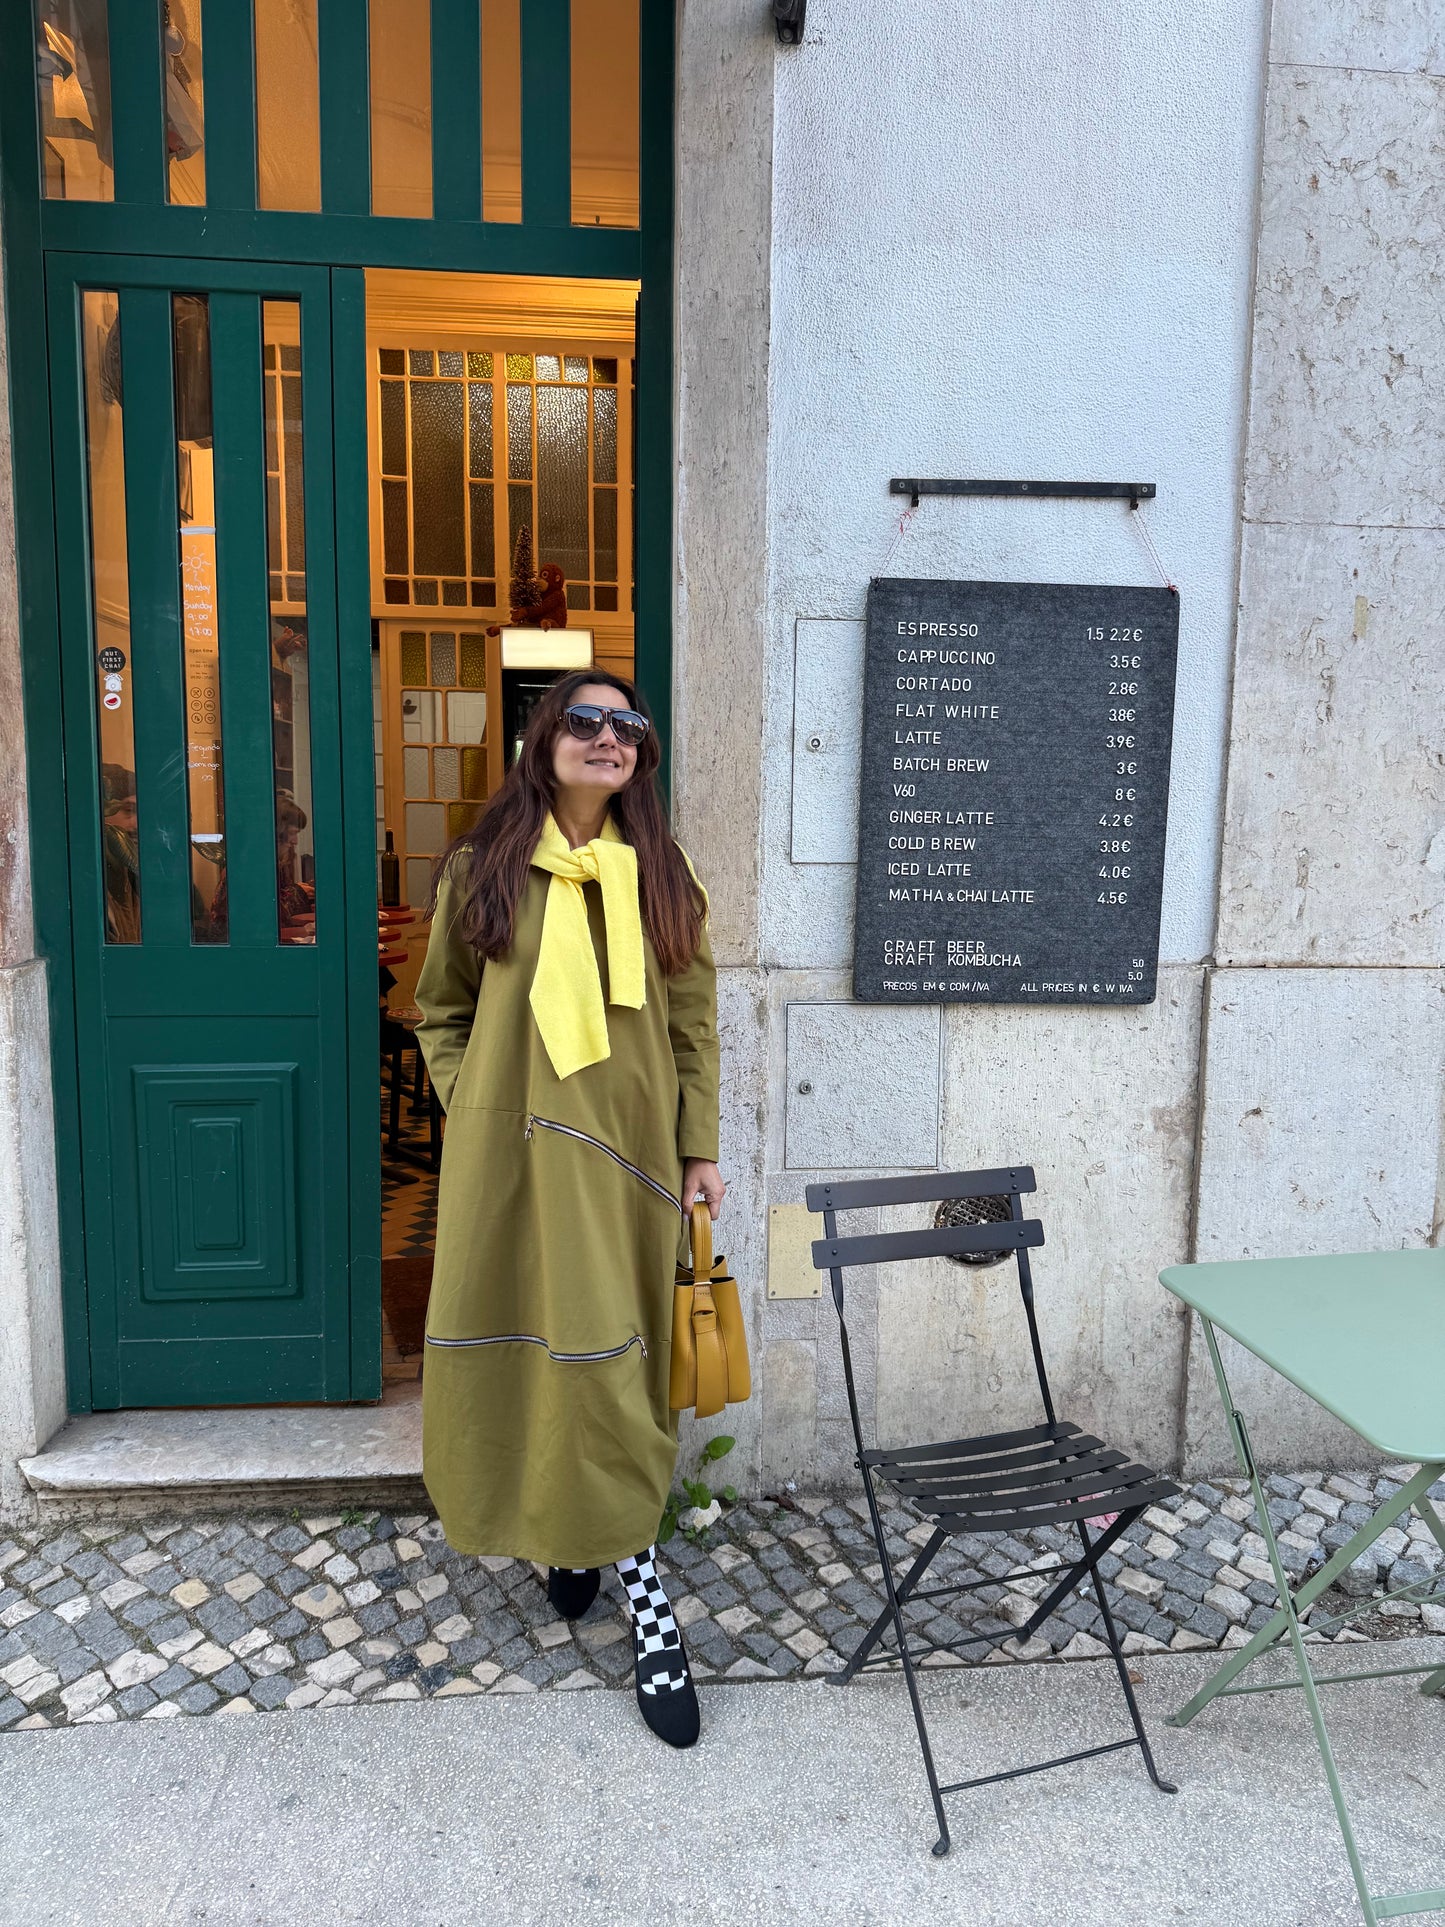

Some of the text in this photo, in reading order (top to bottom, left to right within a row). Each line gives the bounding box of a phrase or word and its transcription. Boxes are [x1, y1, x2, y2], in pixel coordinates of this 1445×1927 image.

[183, 600, 212, 613] Sunday
[898, 622, 978, 637] ESPRESSO
[1087, 628, 1103, 640] 1.5
[898, 650, 995, 665] CAPPUCCINO
[1110, 655, 1140, 668] 3.5€
[896, 677, 972, 691] CORTADO
[1108, 682, 1138, 695] 2.8€
[896, 704, 999, 718] FLAT WHITE
[895, 731, 941, 744] LATTE
[1106, 736, 1135, 748] 3.9€
[893, 757, 989, 771] BATCH BREW
[894, 784, 915, 797] V60
[890, 811, 994, 824] GINGER LATTE
[889, 837, 924, 849] COLD
[1100, 840, 1131, 852] 3.8€
[888, 863, 971, 876] ICED LATTE
[1099, 866, 1131, 878] 4.0€
[890, 889, 1034, 903] MATHA & CHAI LATTE
[1097, 892, 1127, 904] 4.5€
[884, 940, 985, 953] CRAFT BEER
[885, 953, 1021, 966] CRAFT KOMBUCHA
[1128, 972, 1142, 980] 5.0
[883, 981, 917, 990] PRECOS
[923, 982, 936, 990] EM
[1020, 983, 1038, 991] ALL
[1043, 983, 1074, 992] PRICES
[1079, 984, 1087, 992] IN
[1093, 984, 1100, 992] €
[1106, 984, 1115, 992] W
